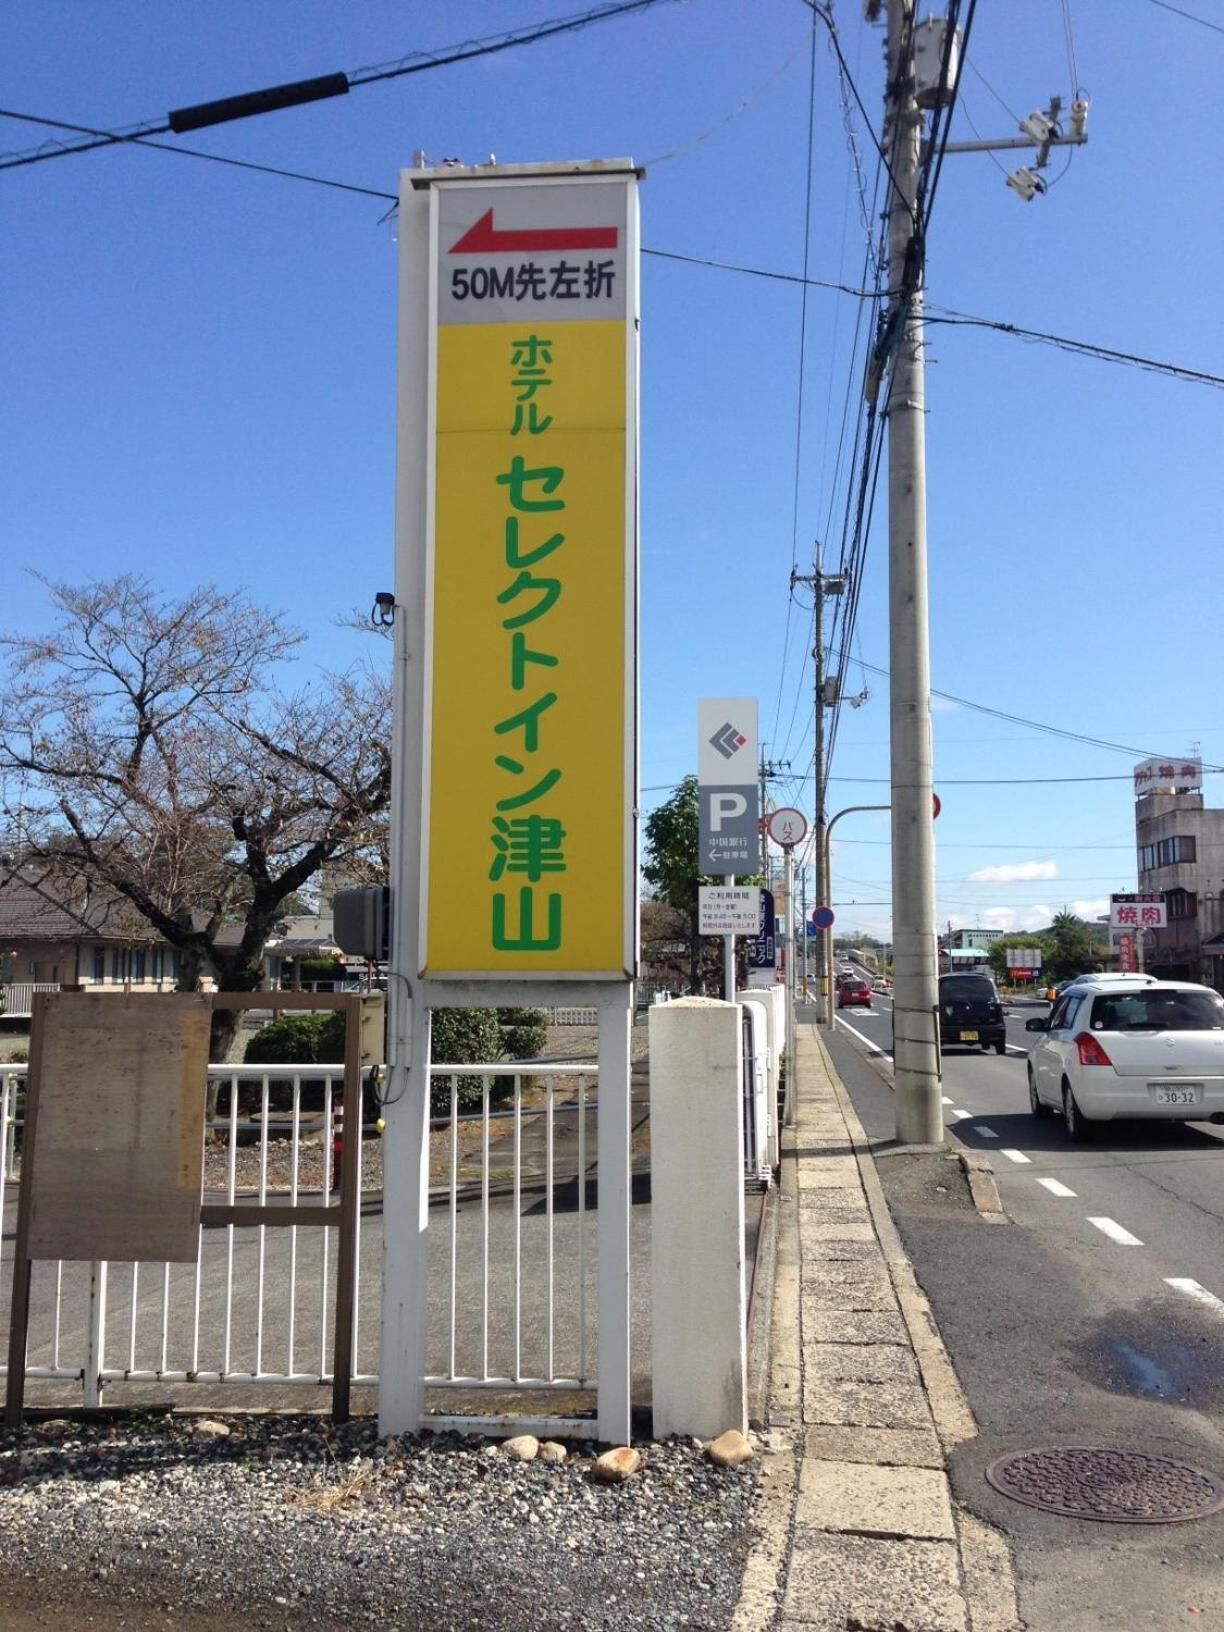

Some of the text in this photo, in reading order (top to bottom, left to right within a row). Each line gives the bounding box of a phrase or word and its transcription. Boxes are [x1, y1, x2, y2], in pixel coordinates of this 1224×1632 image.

[451, 259, 616, 301] 50M先左折
[488, 334, 567, 952] ホテル セレクトイン津山
[709, 792, 748, 832] P
[783, 821, 793, 841] バス
[708, 837, 748, 847] 中国銀行
[708, 891, 750, 900] ご利用時間
[1117, 906, 1161, 927] 焼肉
[1164, 1092, 1194, 1103] 30-32
